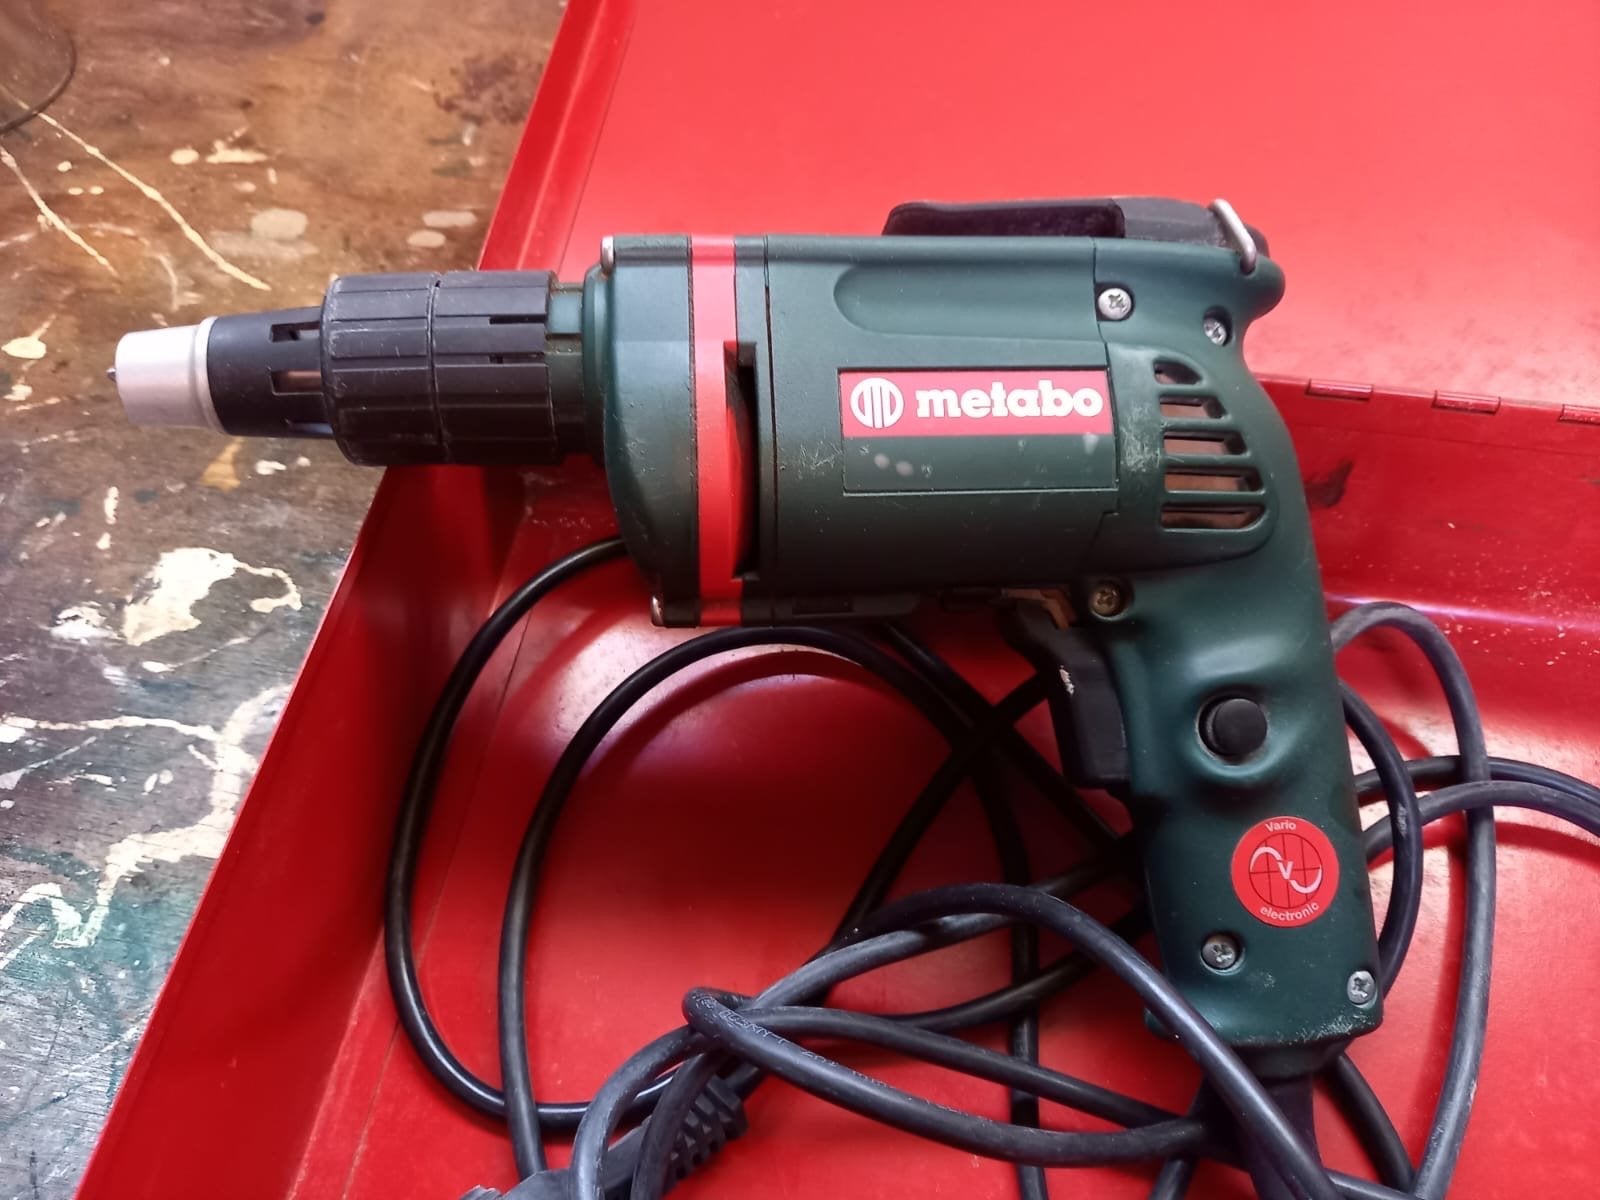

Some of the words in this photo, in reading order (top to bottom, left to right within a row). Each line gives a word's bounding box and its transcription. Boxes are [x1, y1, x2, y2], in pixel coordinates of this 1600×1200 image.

[915, 380, 1103, 418] metabo
[1265, 820, 1296, 832] Vario
[1260, 902, 1319, 921] electronic
